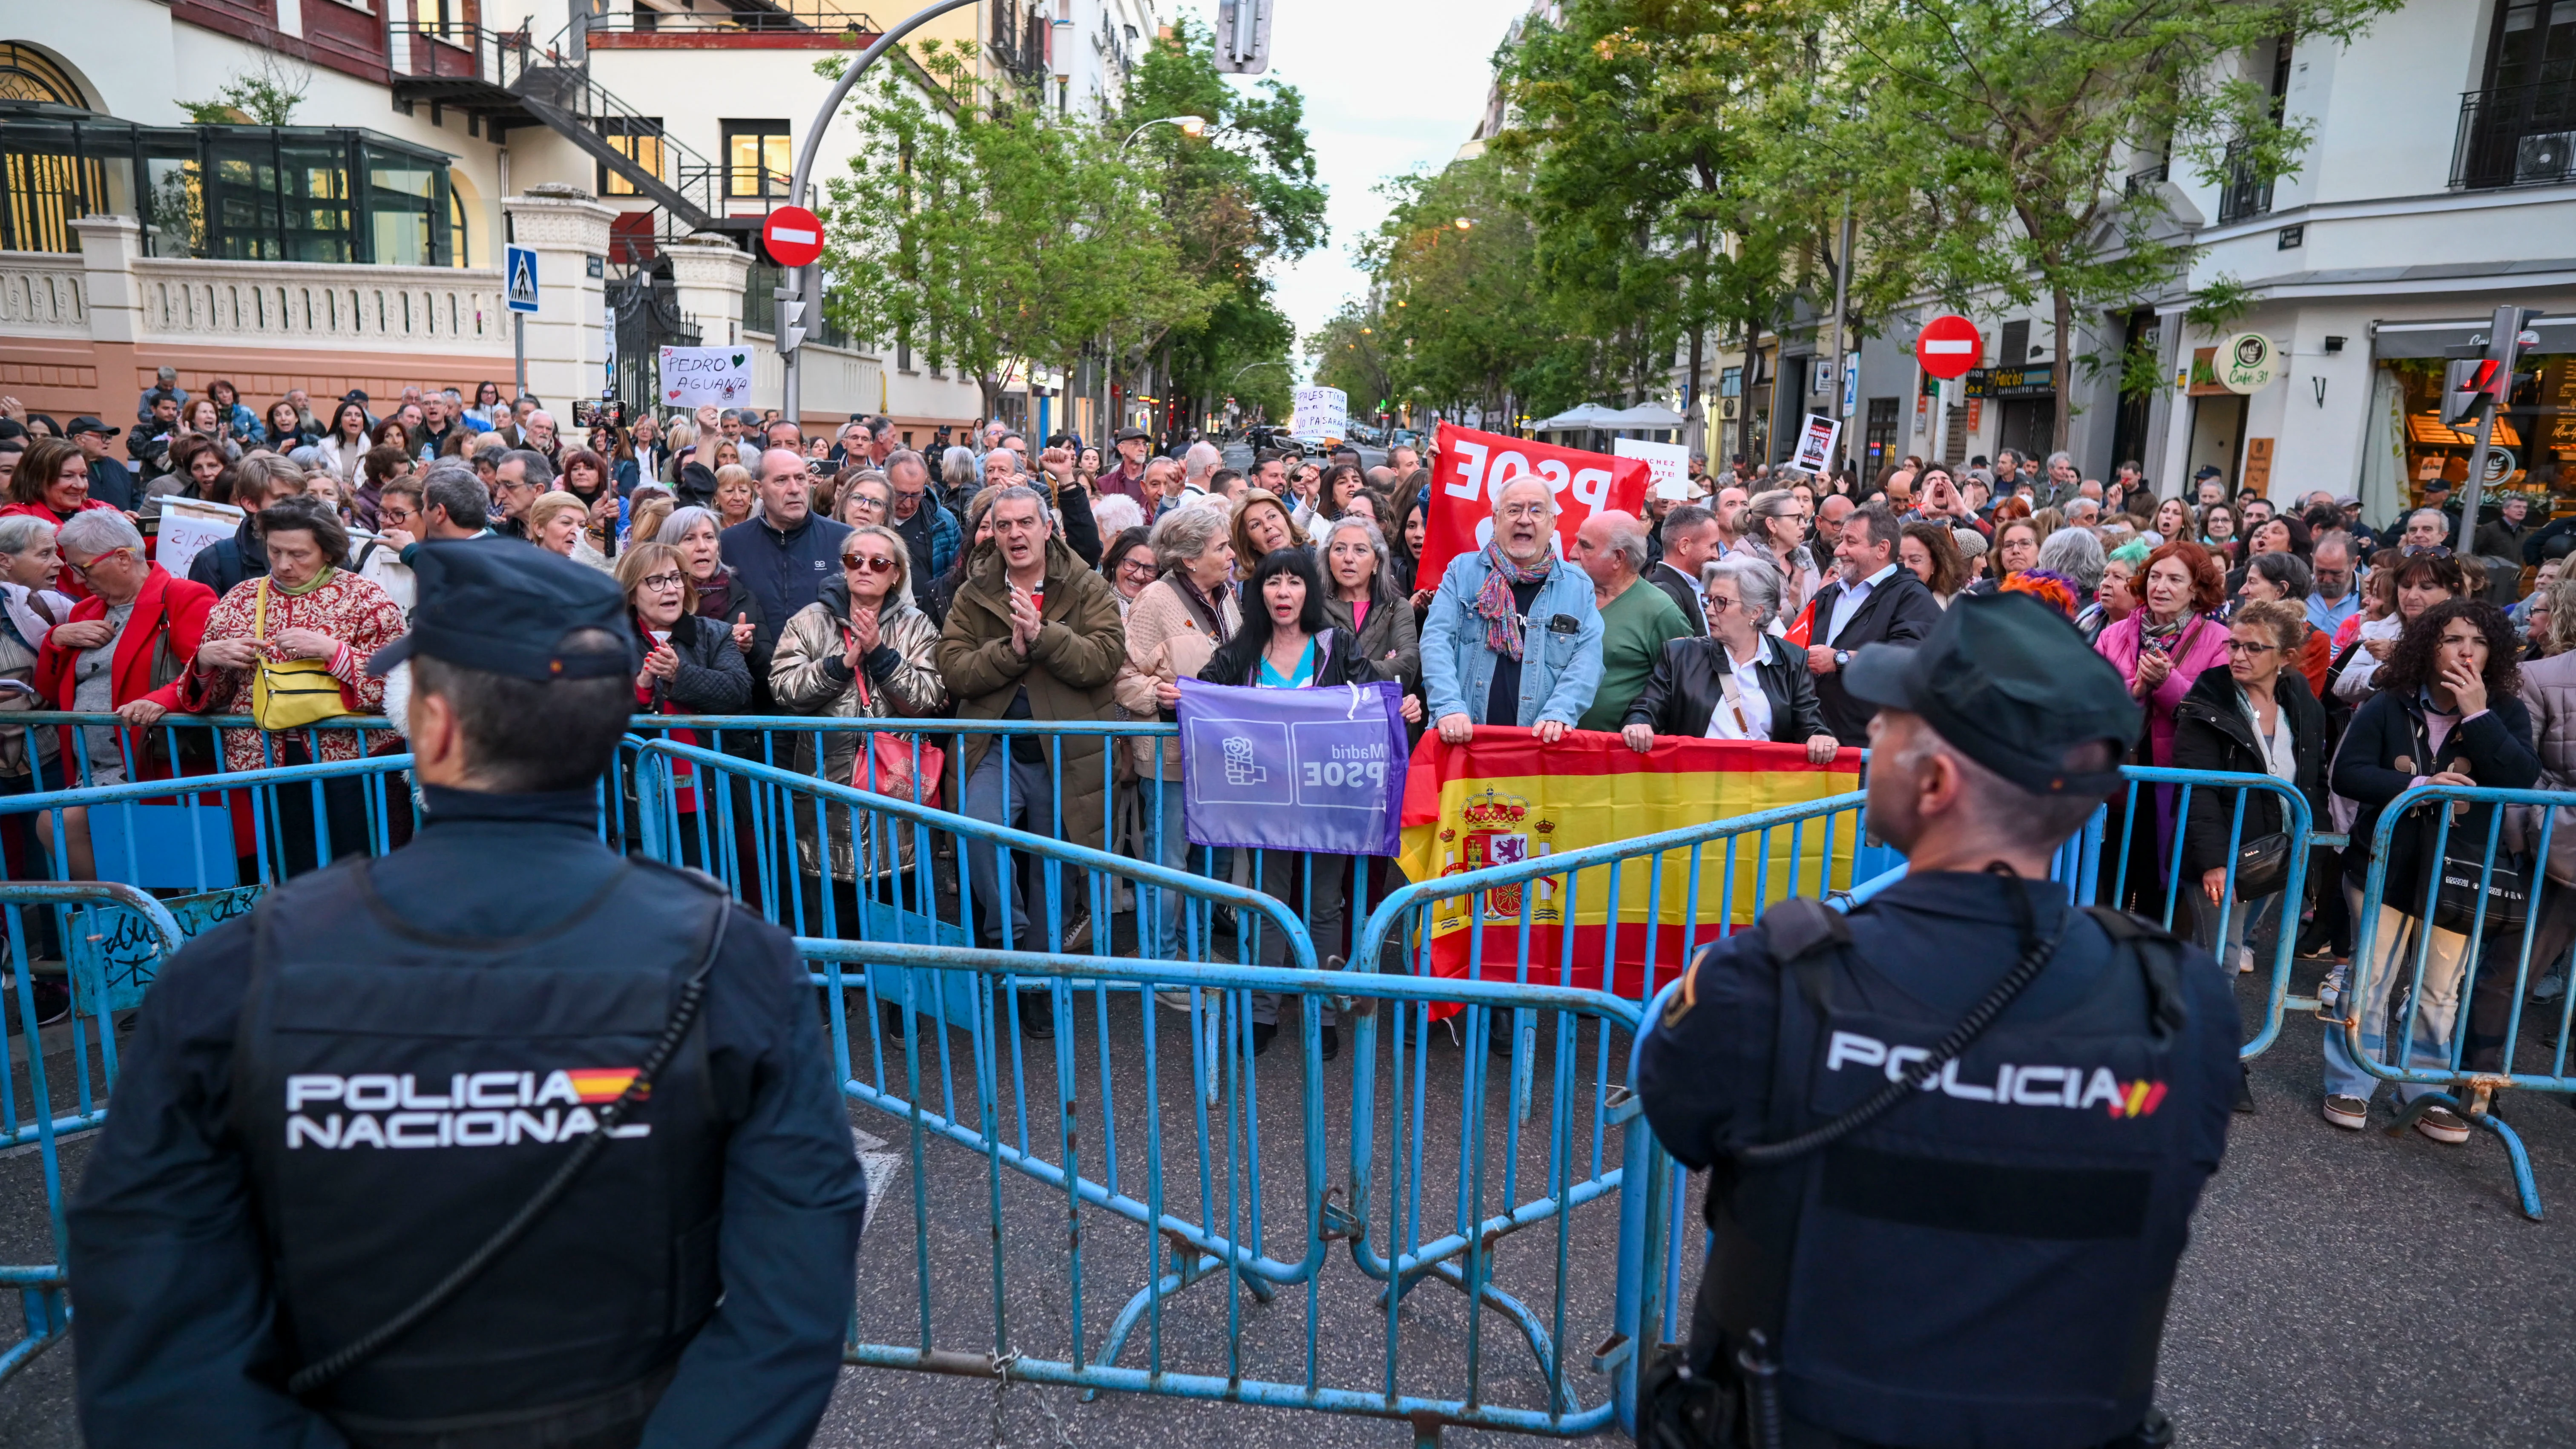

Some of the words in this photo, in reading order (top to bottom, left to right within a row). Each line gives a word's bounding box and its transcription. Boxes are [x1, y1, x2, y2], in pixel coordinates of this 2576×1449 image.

[667, 357, 726, 372] PEDRO
[677, 377, 747, 390] AGUANTA
[2229, 370, 2253, 385] Café
[2257, 370, 2268, 383] 31
[1295, 417, 1306, 431] NO
[1828, 1030, 2125, 1109] POLICIA
[287, 1070, 581, 1111] POLICIA
[287, 1106, 652, 1149] NACIONAL
